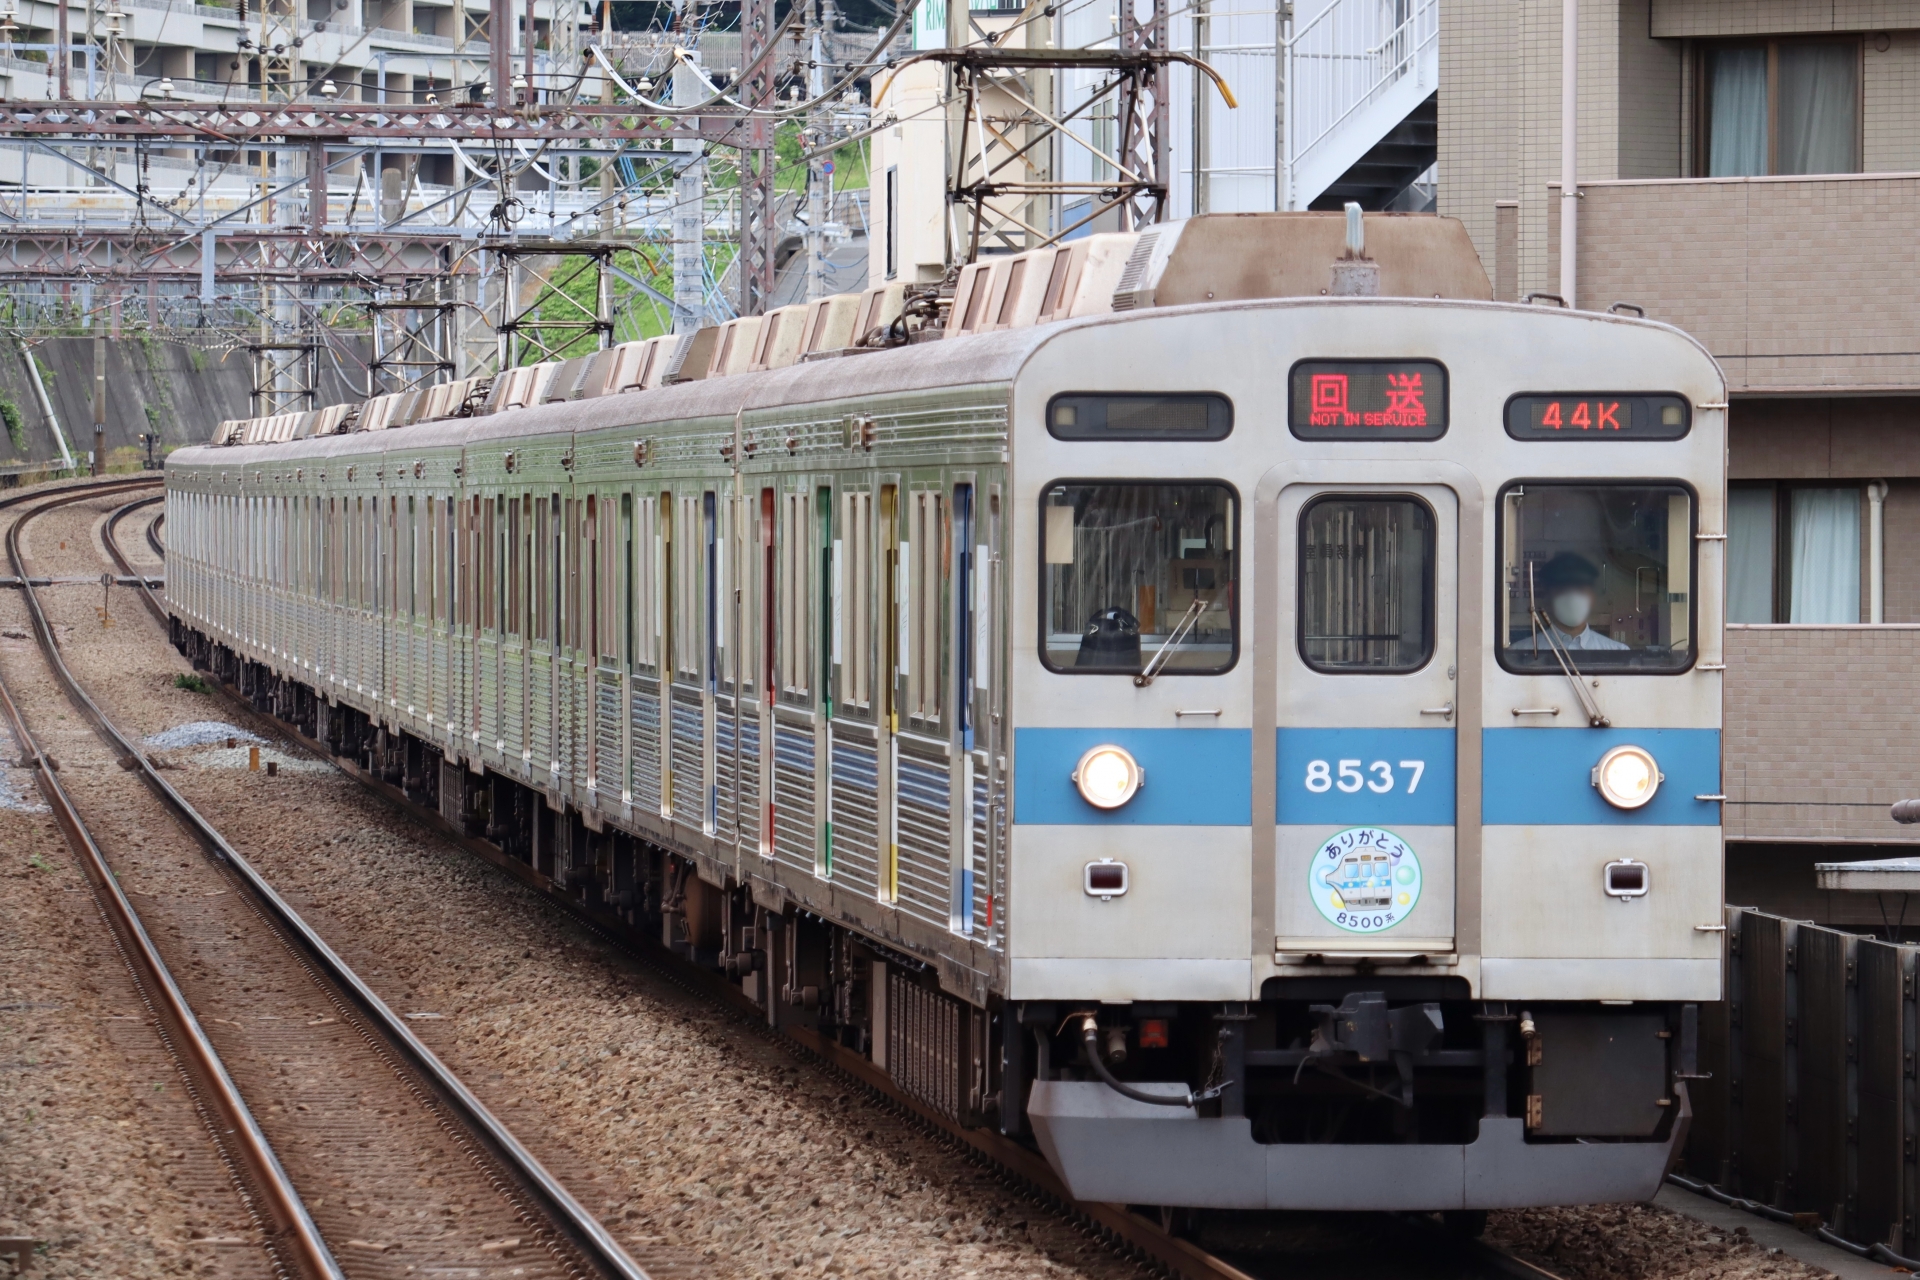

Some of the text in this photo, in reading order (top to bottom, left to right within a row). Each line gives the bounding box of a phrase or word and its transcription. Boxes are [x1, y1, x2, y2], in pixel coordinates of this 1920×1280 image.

[1312, 373, 1426, 413] 回送
[1310, 413, 1427, 426] NOT IN SERVICE
[1542, 402, 1620, 430] 44K
[1305, 759, 1425, 793] 8537
[1325, 830, 1404, 859] ありがとう
[1337, 912, 1396, 928] 8500系
